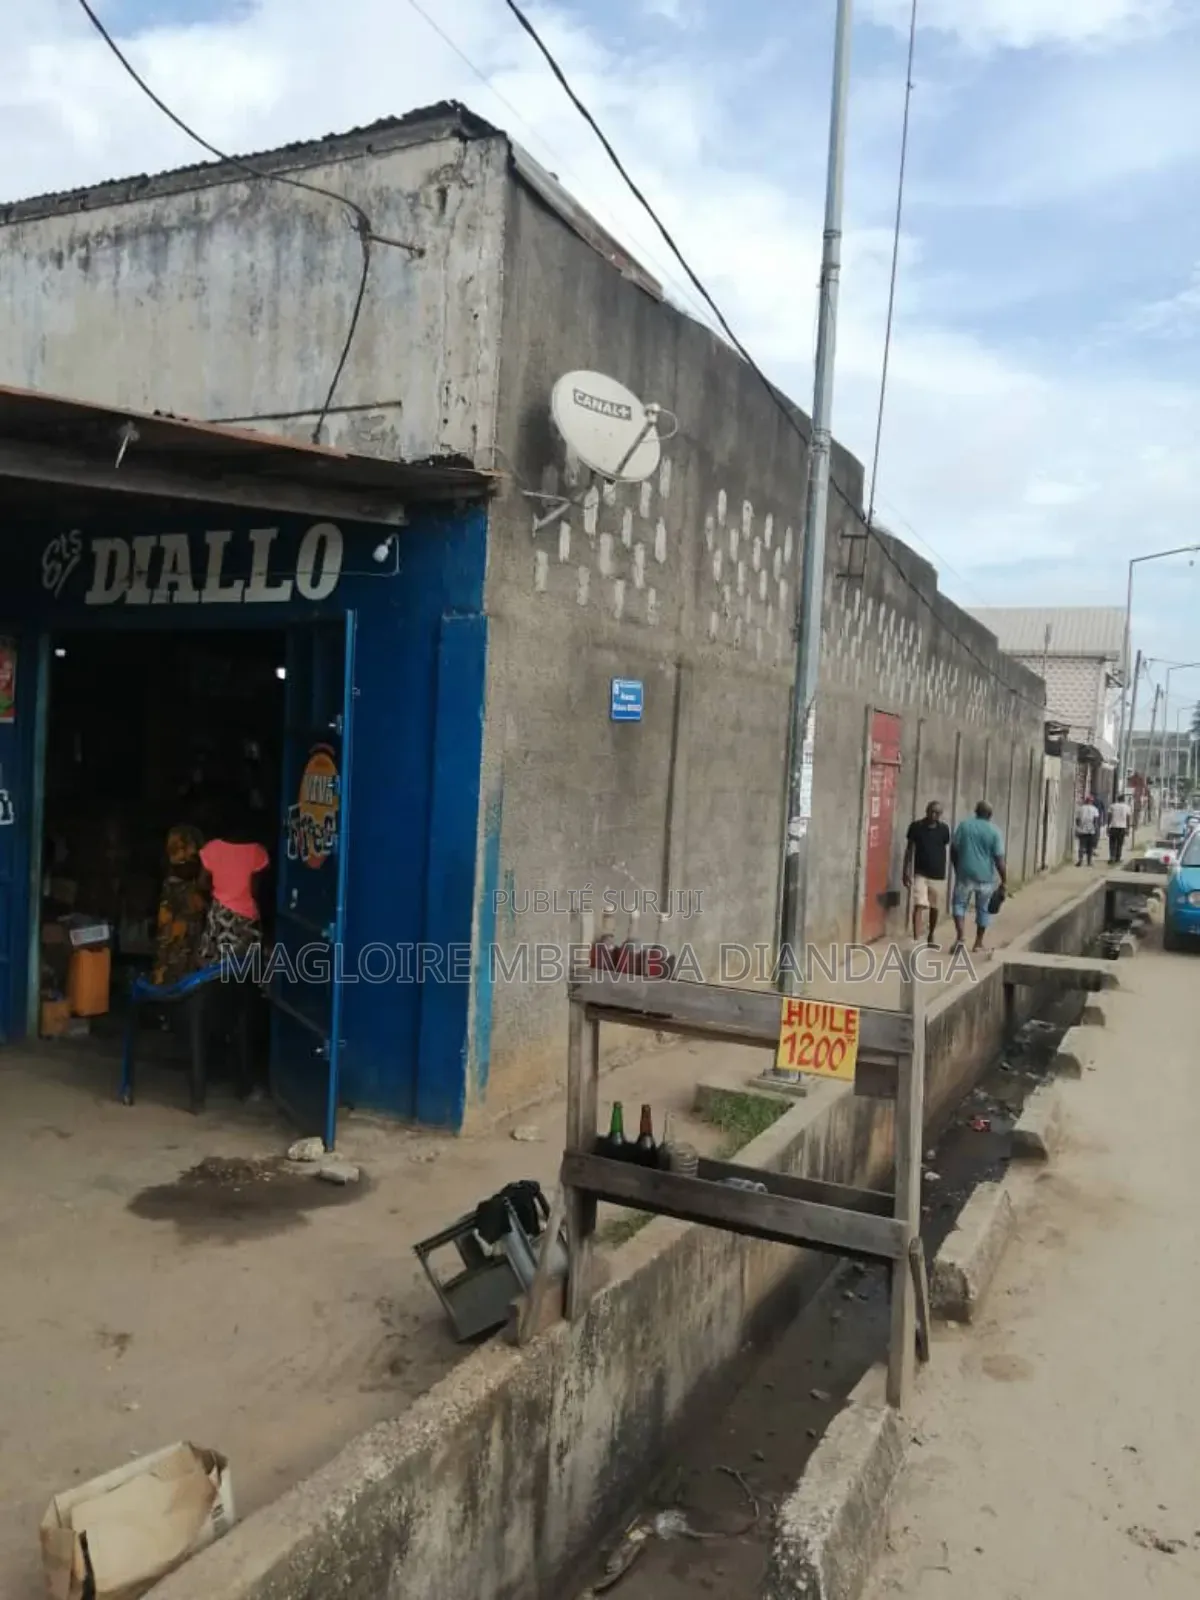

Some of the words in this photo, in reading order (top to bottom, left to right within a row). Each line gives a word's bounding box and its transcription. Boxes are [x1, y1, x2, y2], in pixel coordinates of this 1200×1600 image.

[574, 390, 631, 419] CANAL+
[85, 523, 344, 605] DIALLO
[783, 999, 858, 1035] HUILE
